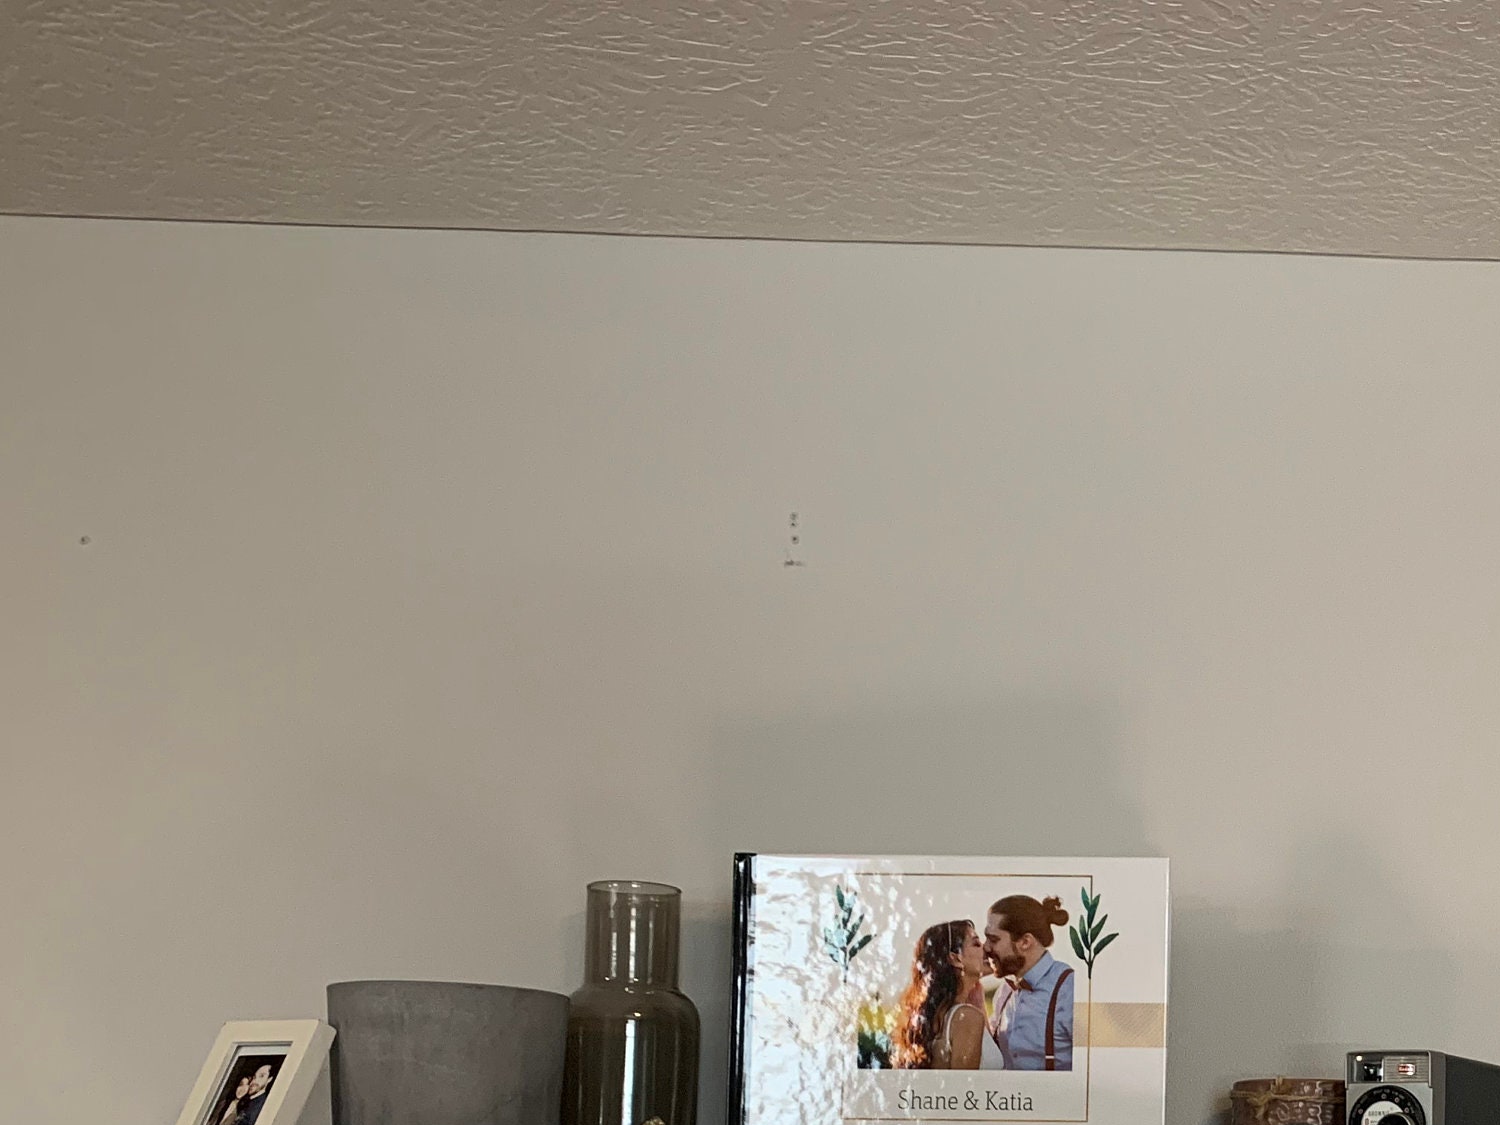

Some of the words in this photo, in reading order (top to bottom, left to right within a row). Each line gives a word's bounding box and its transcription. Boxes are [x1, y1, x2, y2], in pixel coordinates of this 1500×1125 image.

[897, 1089, 958, 1111] Shane
[963, 1090, 980, 1111] &
[985, 1090, 1034, 1111] Katia
